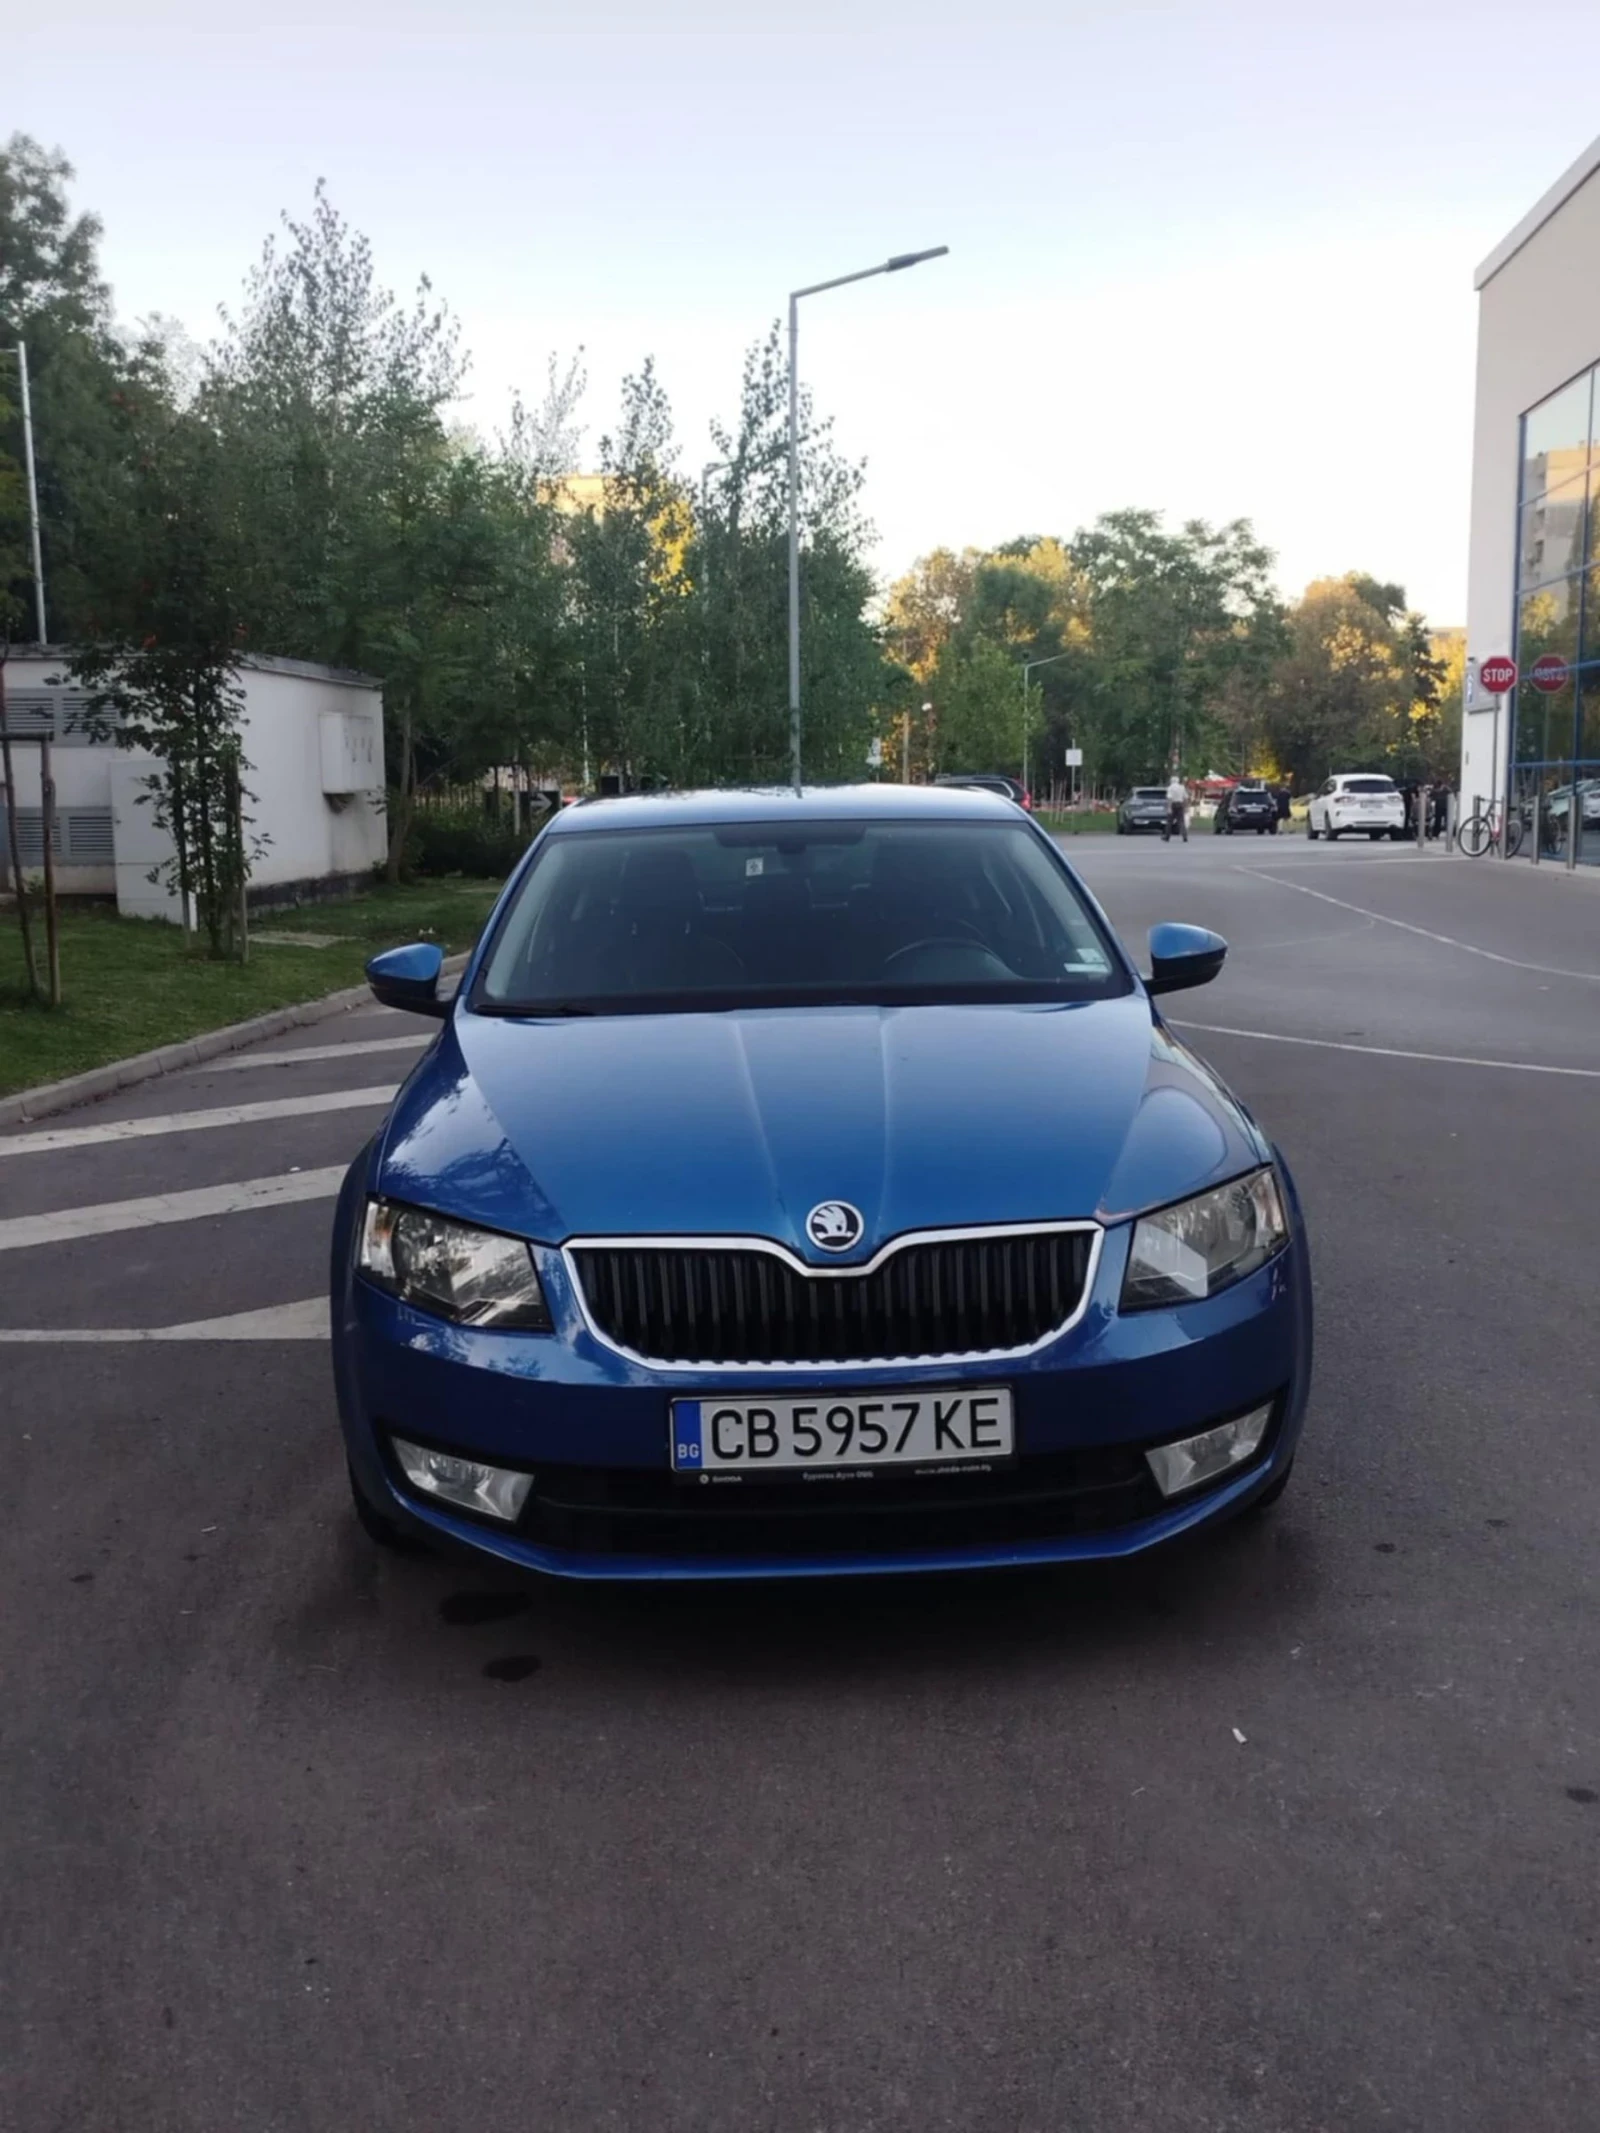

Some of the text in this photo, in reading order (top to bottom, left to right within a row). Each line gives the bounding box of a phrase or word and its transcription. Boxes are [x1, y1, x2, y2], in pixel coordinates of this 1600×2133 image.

[1483, 668, 1513, 682] STOP
[711, 1397, 1002, 1460] CB 5957 KE
[677, 1443, 700, 1459] BG
